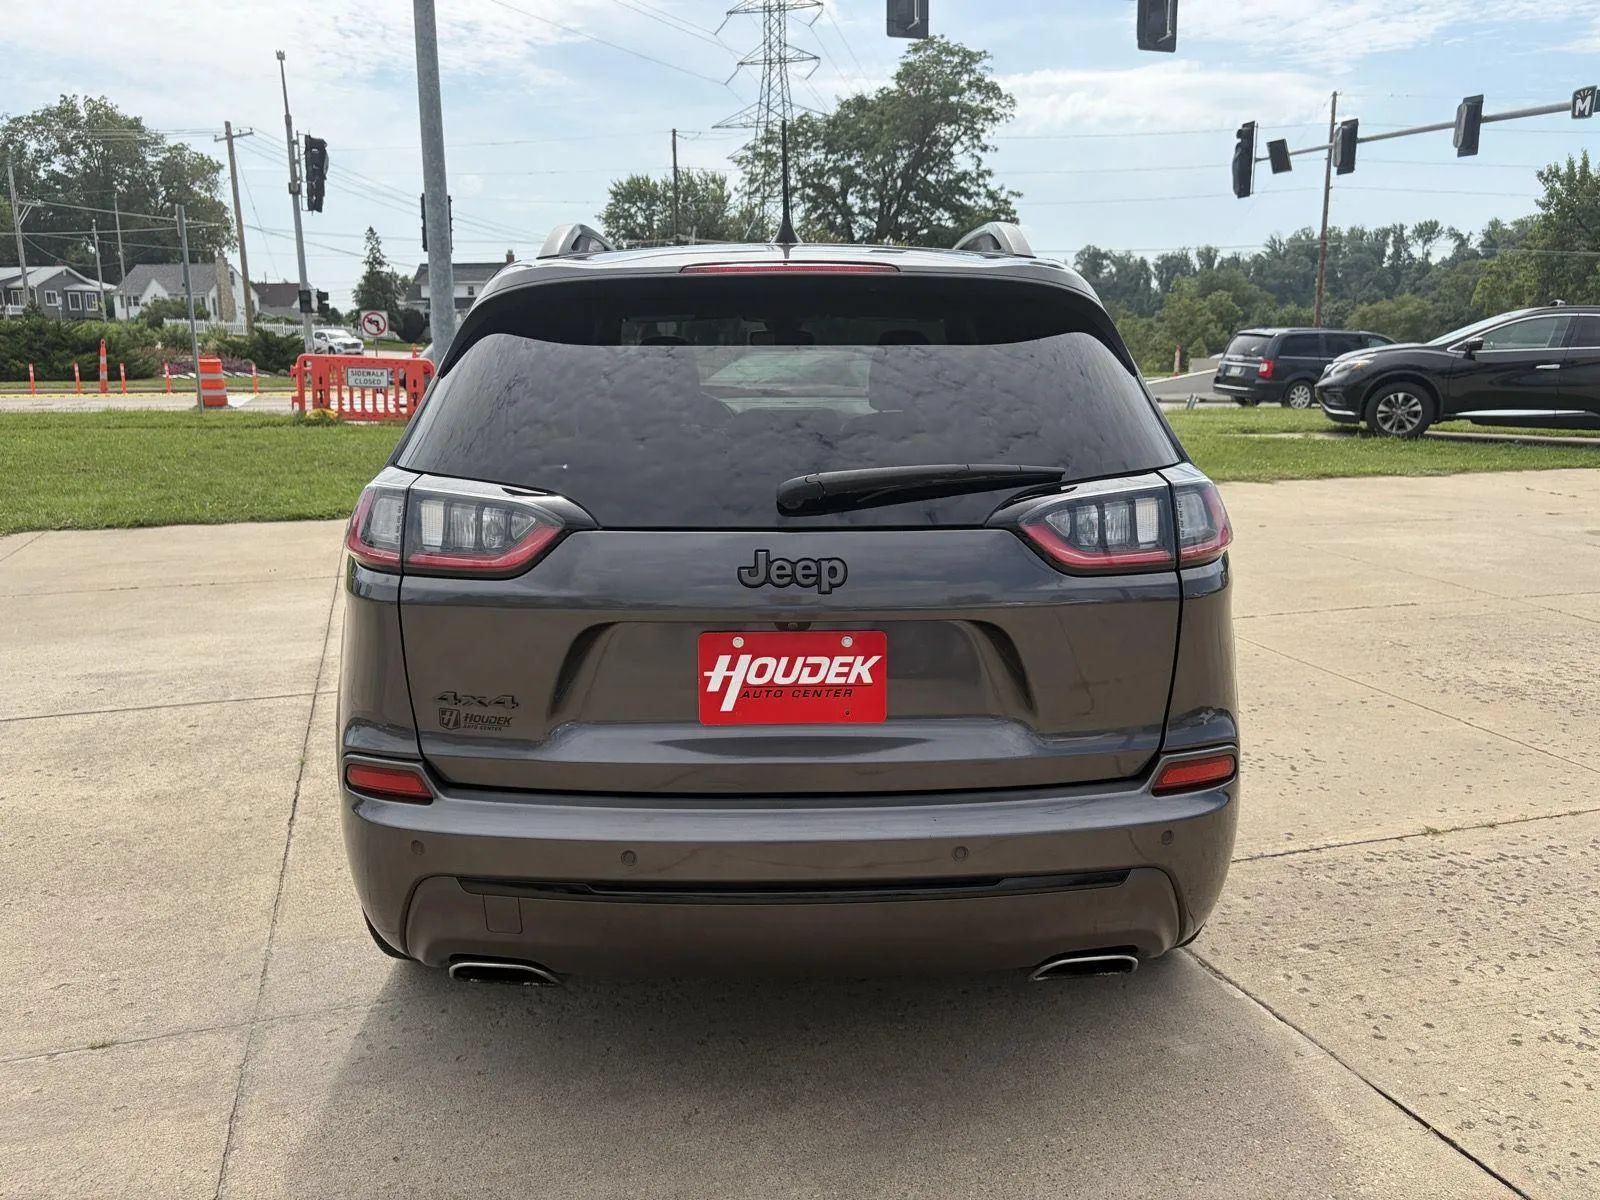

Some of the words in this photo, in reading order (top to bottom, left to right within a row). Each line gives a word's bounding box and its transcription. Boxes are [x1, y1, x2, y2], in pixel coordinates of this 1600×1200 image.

[737, 549, 848, 595] Jeep
[703, 654, 882, 712] HOUDEK
[740, 689, 784, 699] AUTO
[791, 688, 853, 698] CENTER
[463, 713, 513, 726] HOUDEK
